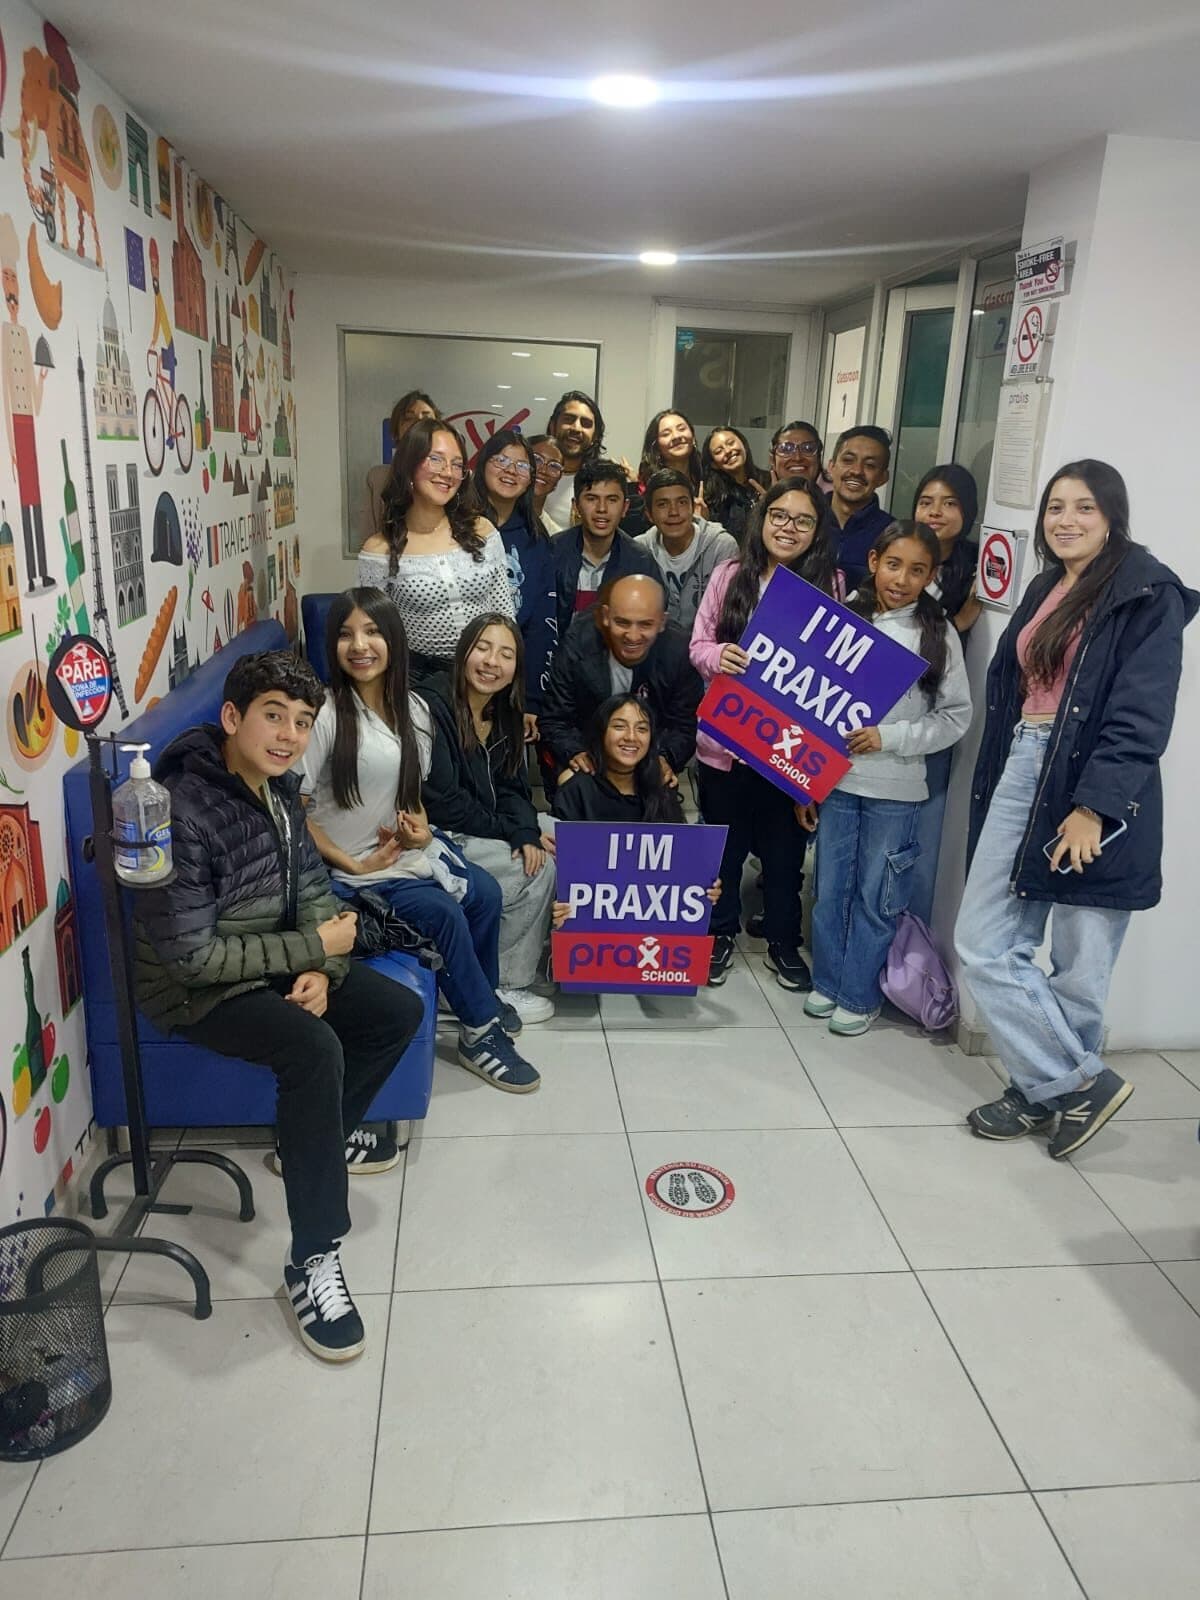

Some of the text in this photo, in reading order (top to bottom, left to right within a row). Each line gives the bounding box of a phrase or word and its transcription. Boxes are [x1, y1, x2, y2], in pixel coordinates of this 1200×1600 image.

[1018, 251, 1055, 269] SMOKE-FREE
[1019, 268, 1033, 279] AREA
[1034, 277, 1044, 287] You
[994, 317, 1008, 351] 2
[842, 393, 847, 417] 1
[799, 605, 874, 674] I'M
[62, 658, 103, 684] PARE
[747, 632, 871, 738] PRAXIS
[712, 690, 828, 776] praxis
[769, 753, 811, 790] SCHOOL
[155, 828, 171, 839] GEL
[608, 833, 673, 871] I'M
[570, 883, 705, 922] PRAXIS
[568, 942, 691, 975] praxis
[641, 970, 690, 983] SCHOOL
